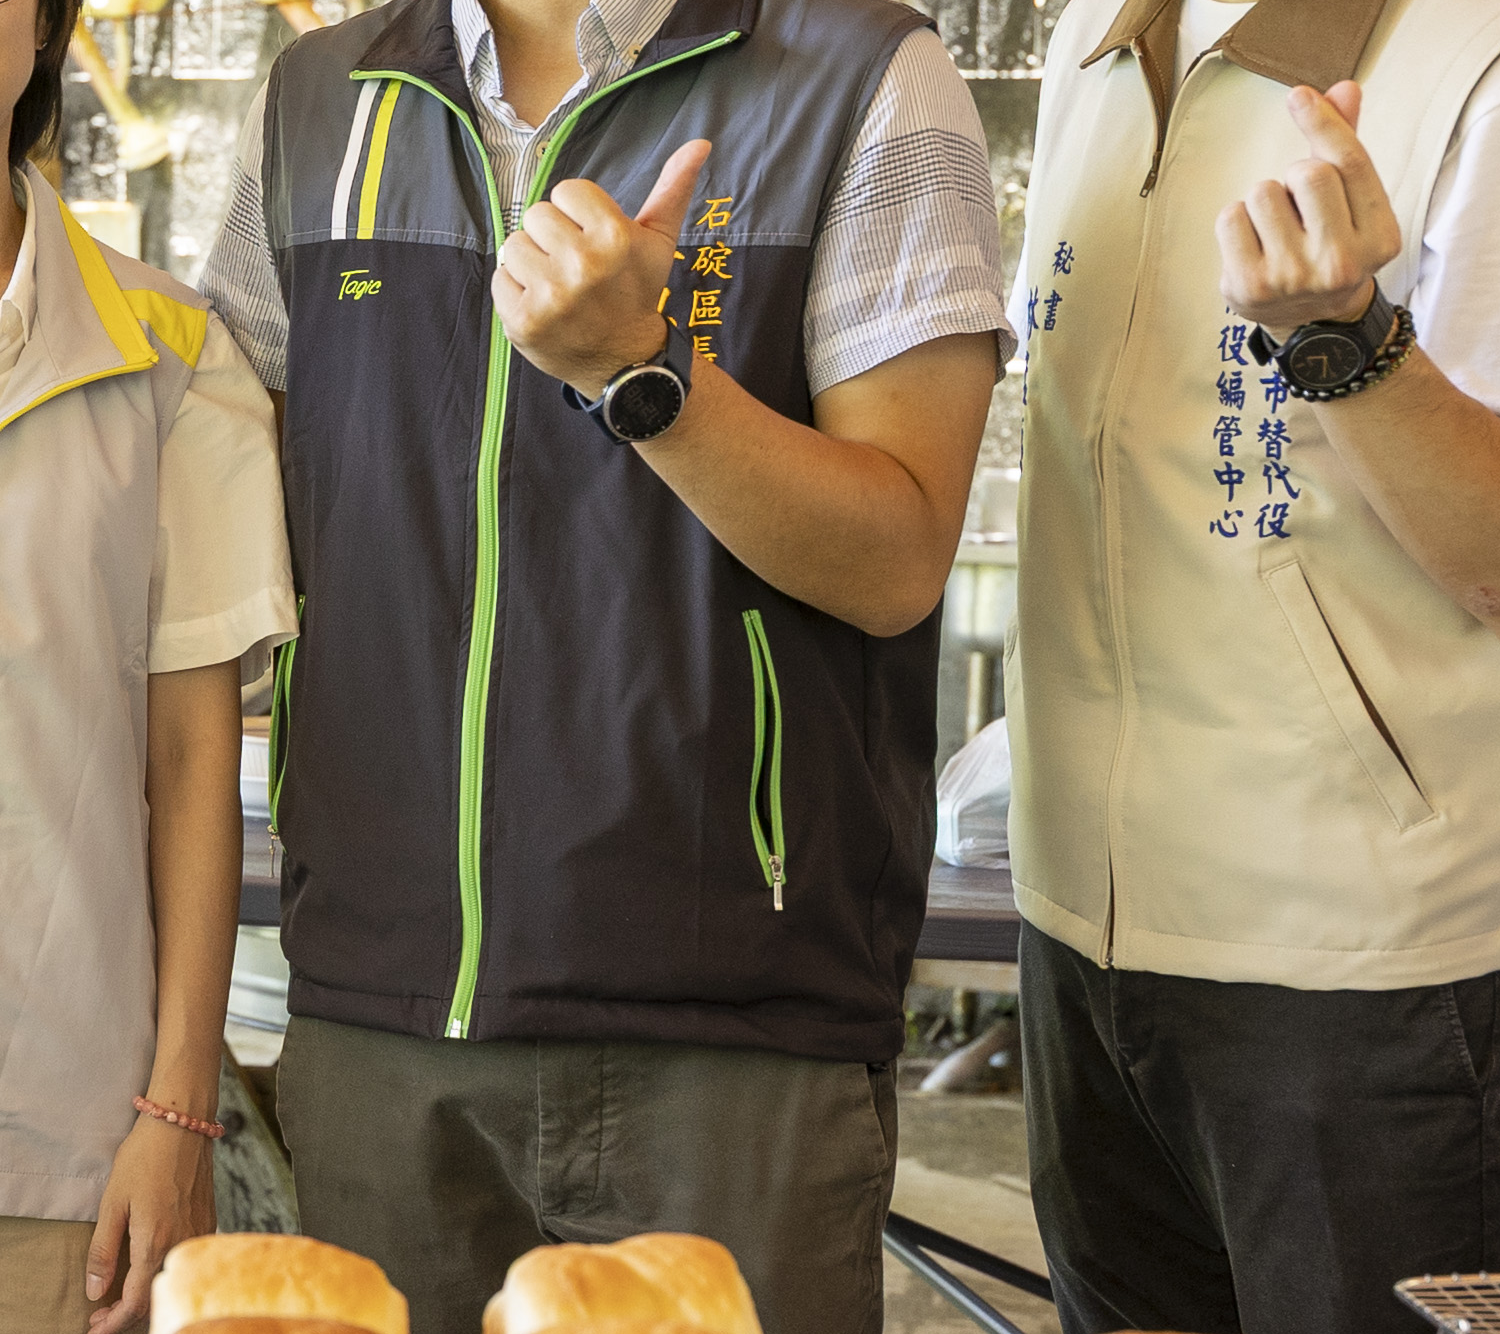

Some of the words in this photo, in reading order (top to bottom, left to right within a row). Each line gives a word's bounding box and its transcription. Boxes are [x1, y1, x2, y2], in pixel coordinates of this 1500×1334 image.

[338, 269, 382, 301] Tagic
[1044, 241, 1075, 331] 秘書
[1209, 305, 1249, 538] 役編管中心
[1254, 353, 1301, 539] 市替代役
